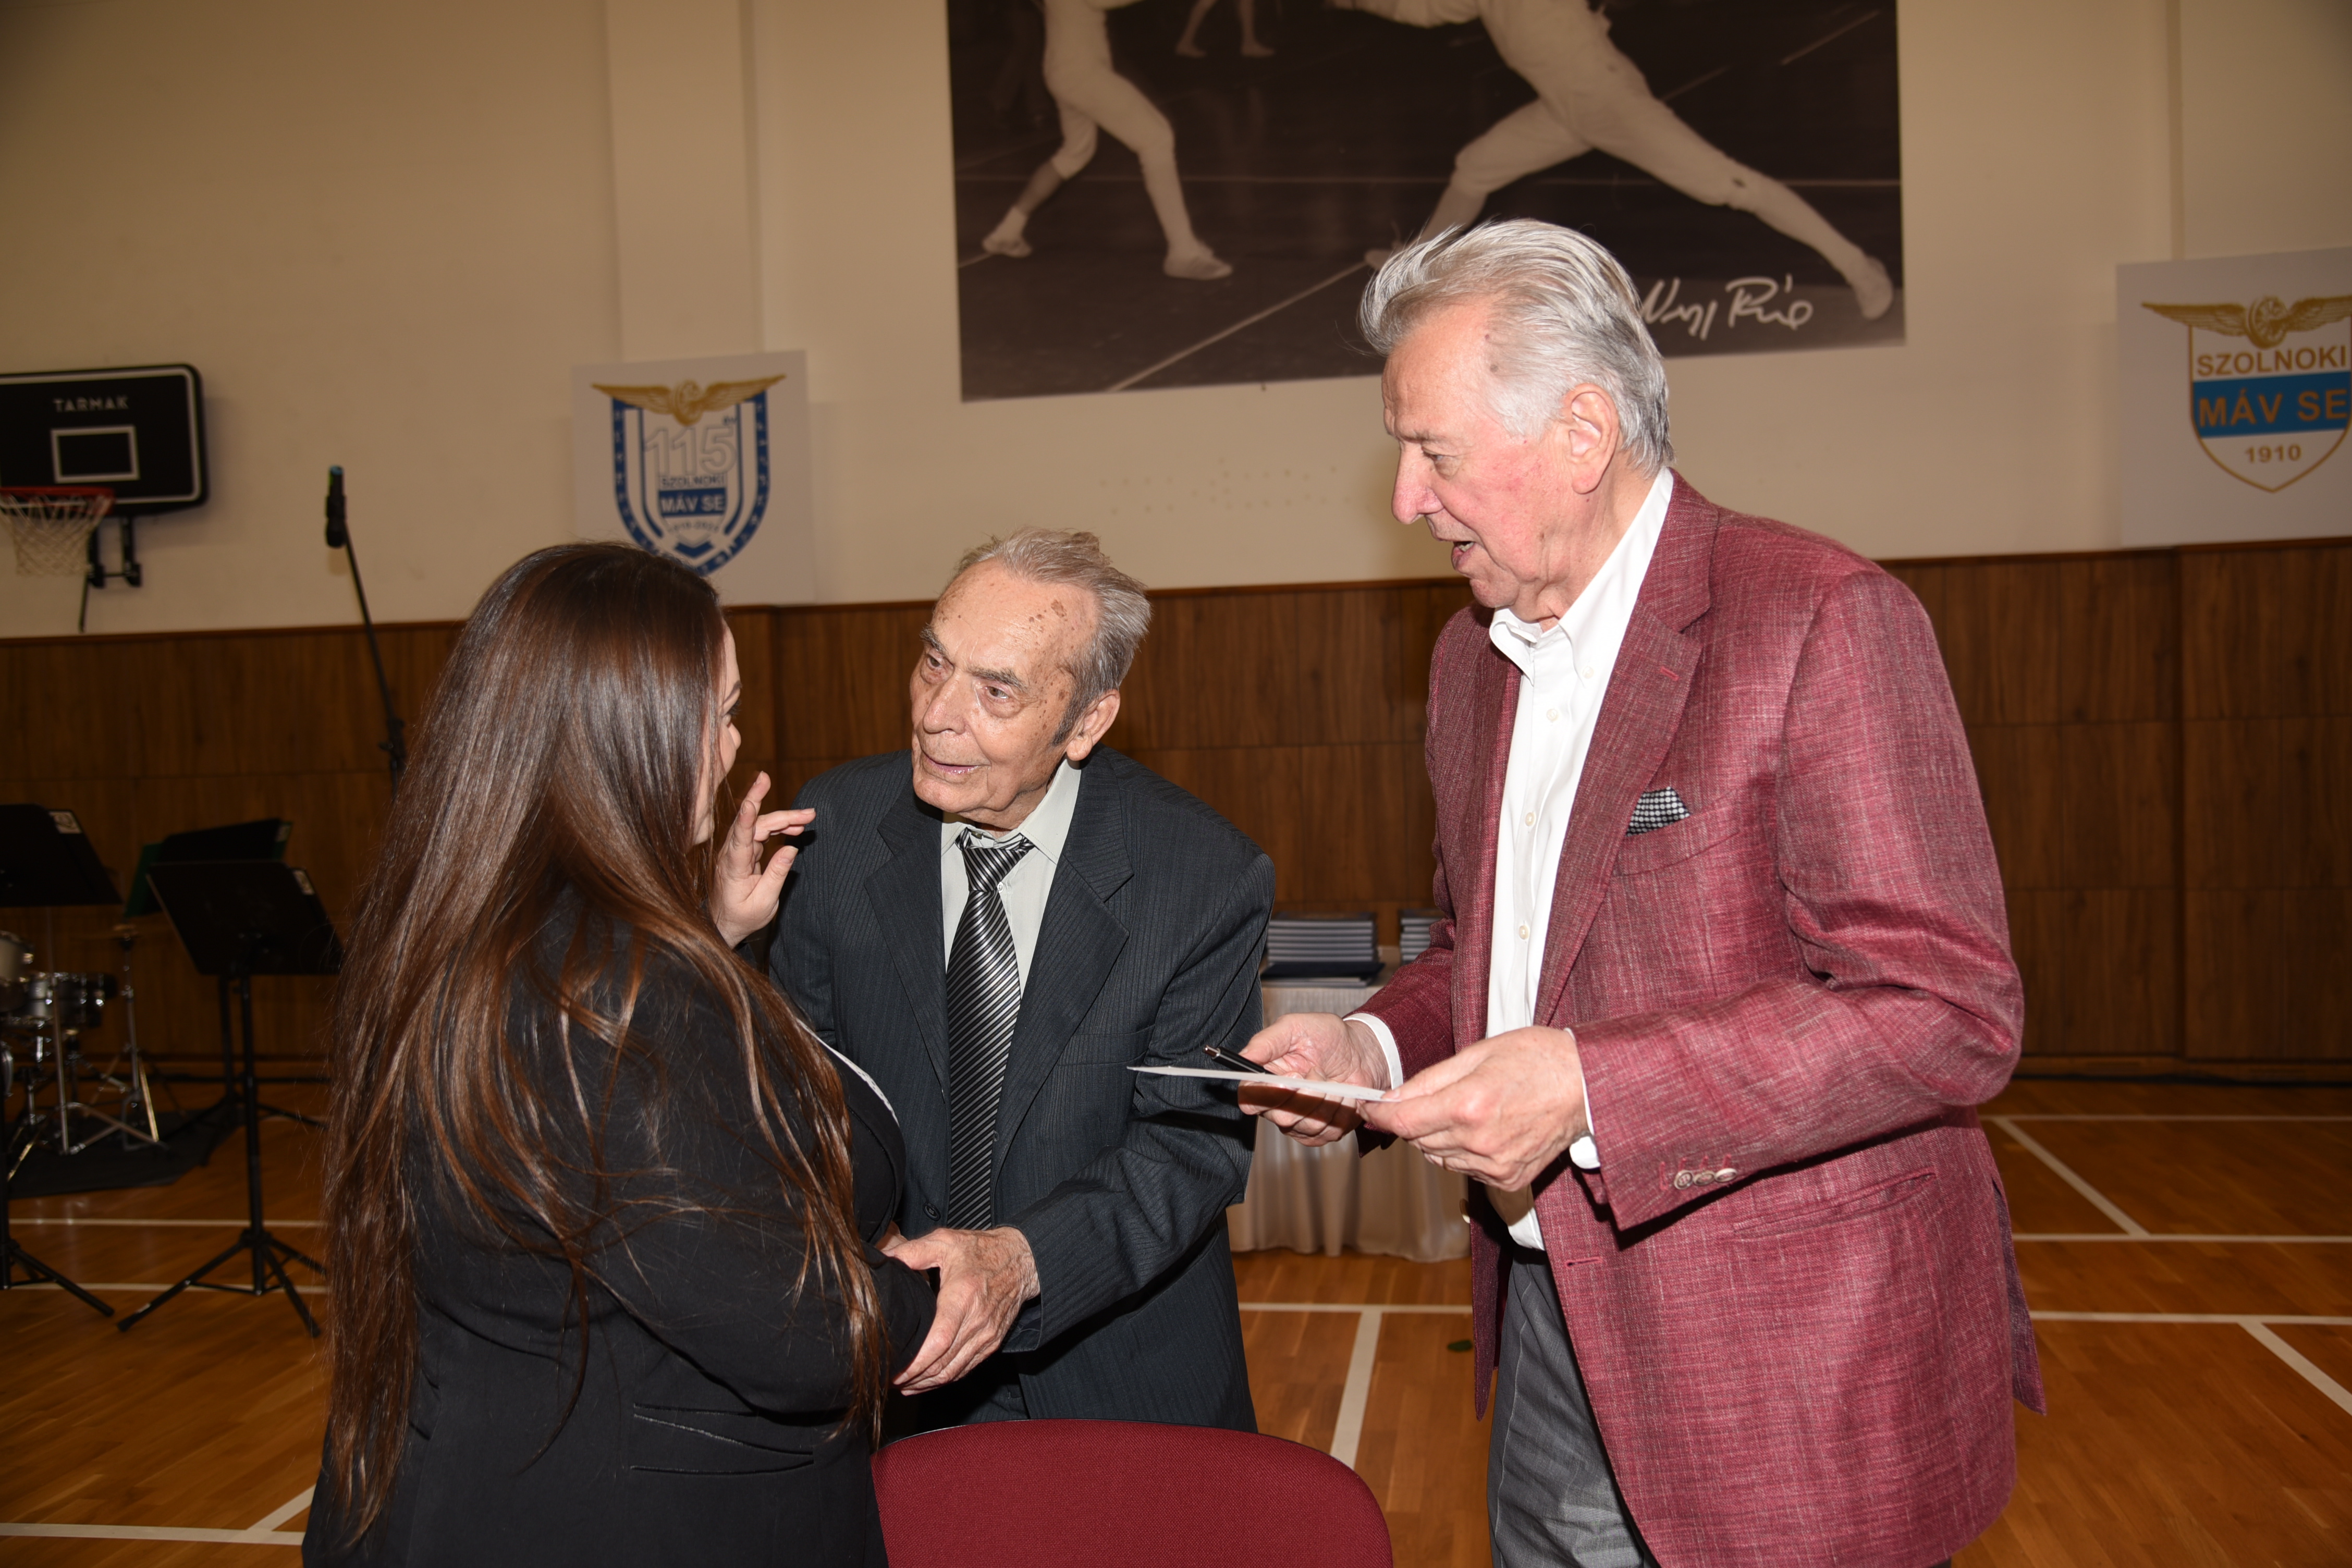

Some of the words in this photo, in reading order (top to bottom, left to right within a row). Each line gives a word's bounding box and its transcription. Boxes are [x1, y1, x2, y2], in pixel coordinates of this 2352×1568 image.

[2197, 346, 2346, 377] SZOLNOKI
[54, 395, 129, 412] TARMAK
[2198, 388, 2283, 427] MÁV
[2297, 389, 2347, 421] SE
[645, 425, 737, 476] 115
[2245, 444, 2302, 463] 1910
[661, 475, 725, 487] SZOLNOKI
[661, 493, 699, 513] MÁV
[701, 494, 725, 511] SE
